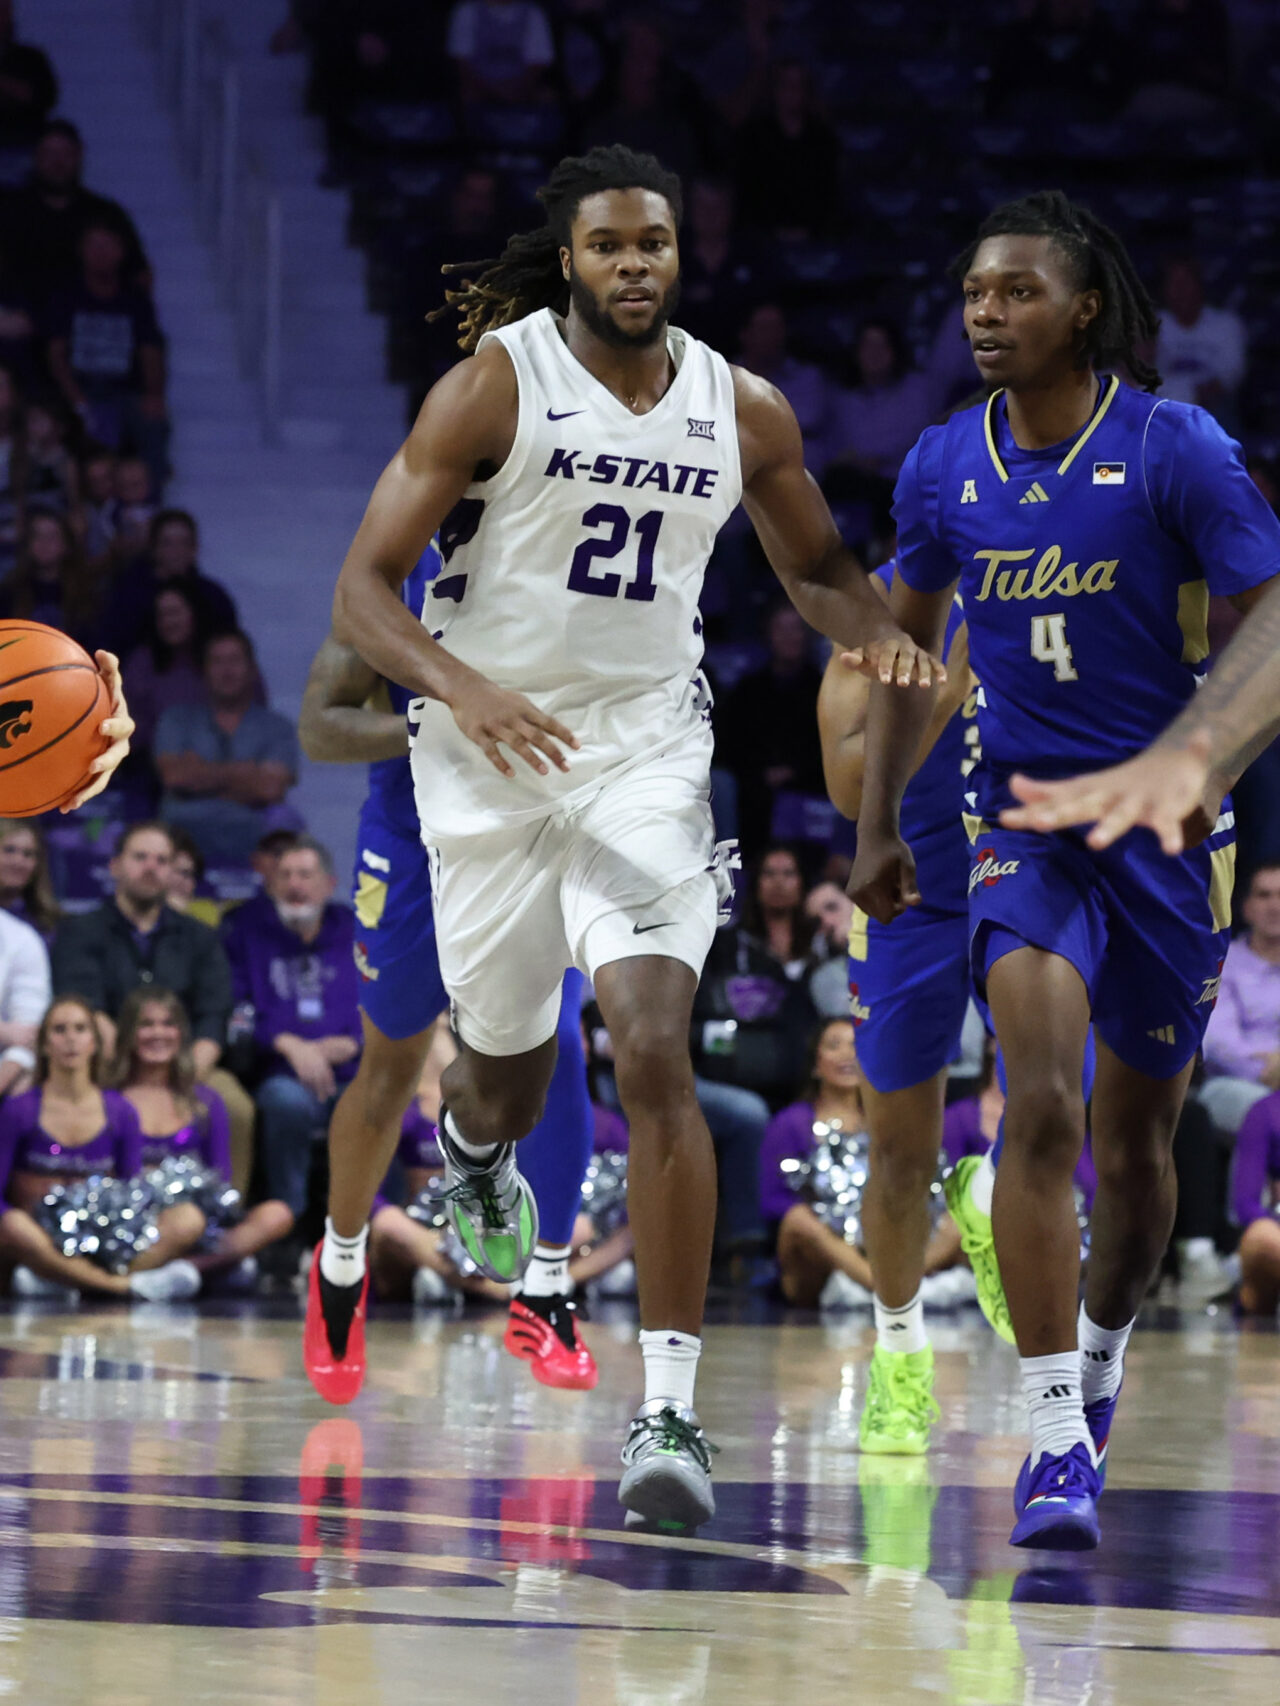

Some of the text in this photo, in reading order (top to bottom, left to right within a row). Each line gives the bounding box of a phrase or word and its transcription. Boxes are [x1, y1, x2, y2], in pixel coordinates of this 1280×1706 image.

[544, 448, 719, 499] K-STATE
[566, 502, 664, 602] 21
[973, 545, 1120, 602] Tulsa
[1030, 613, 1079, 682] 4
